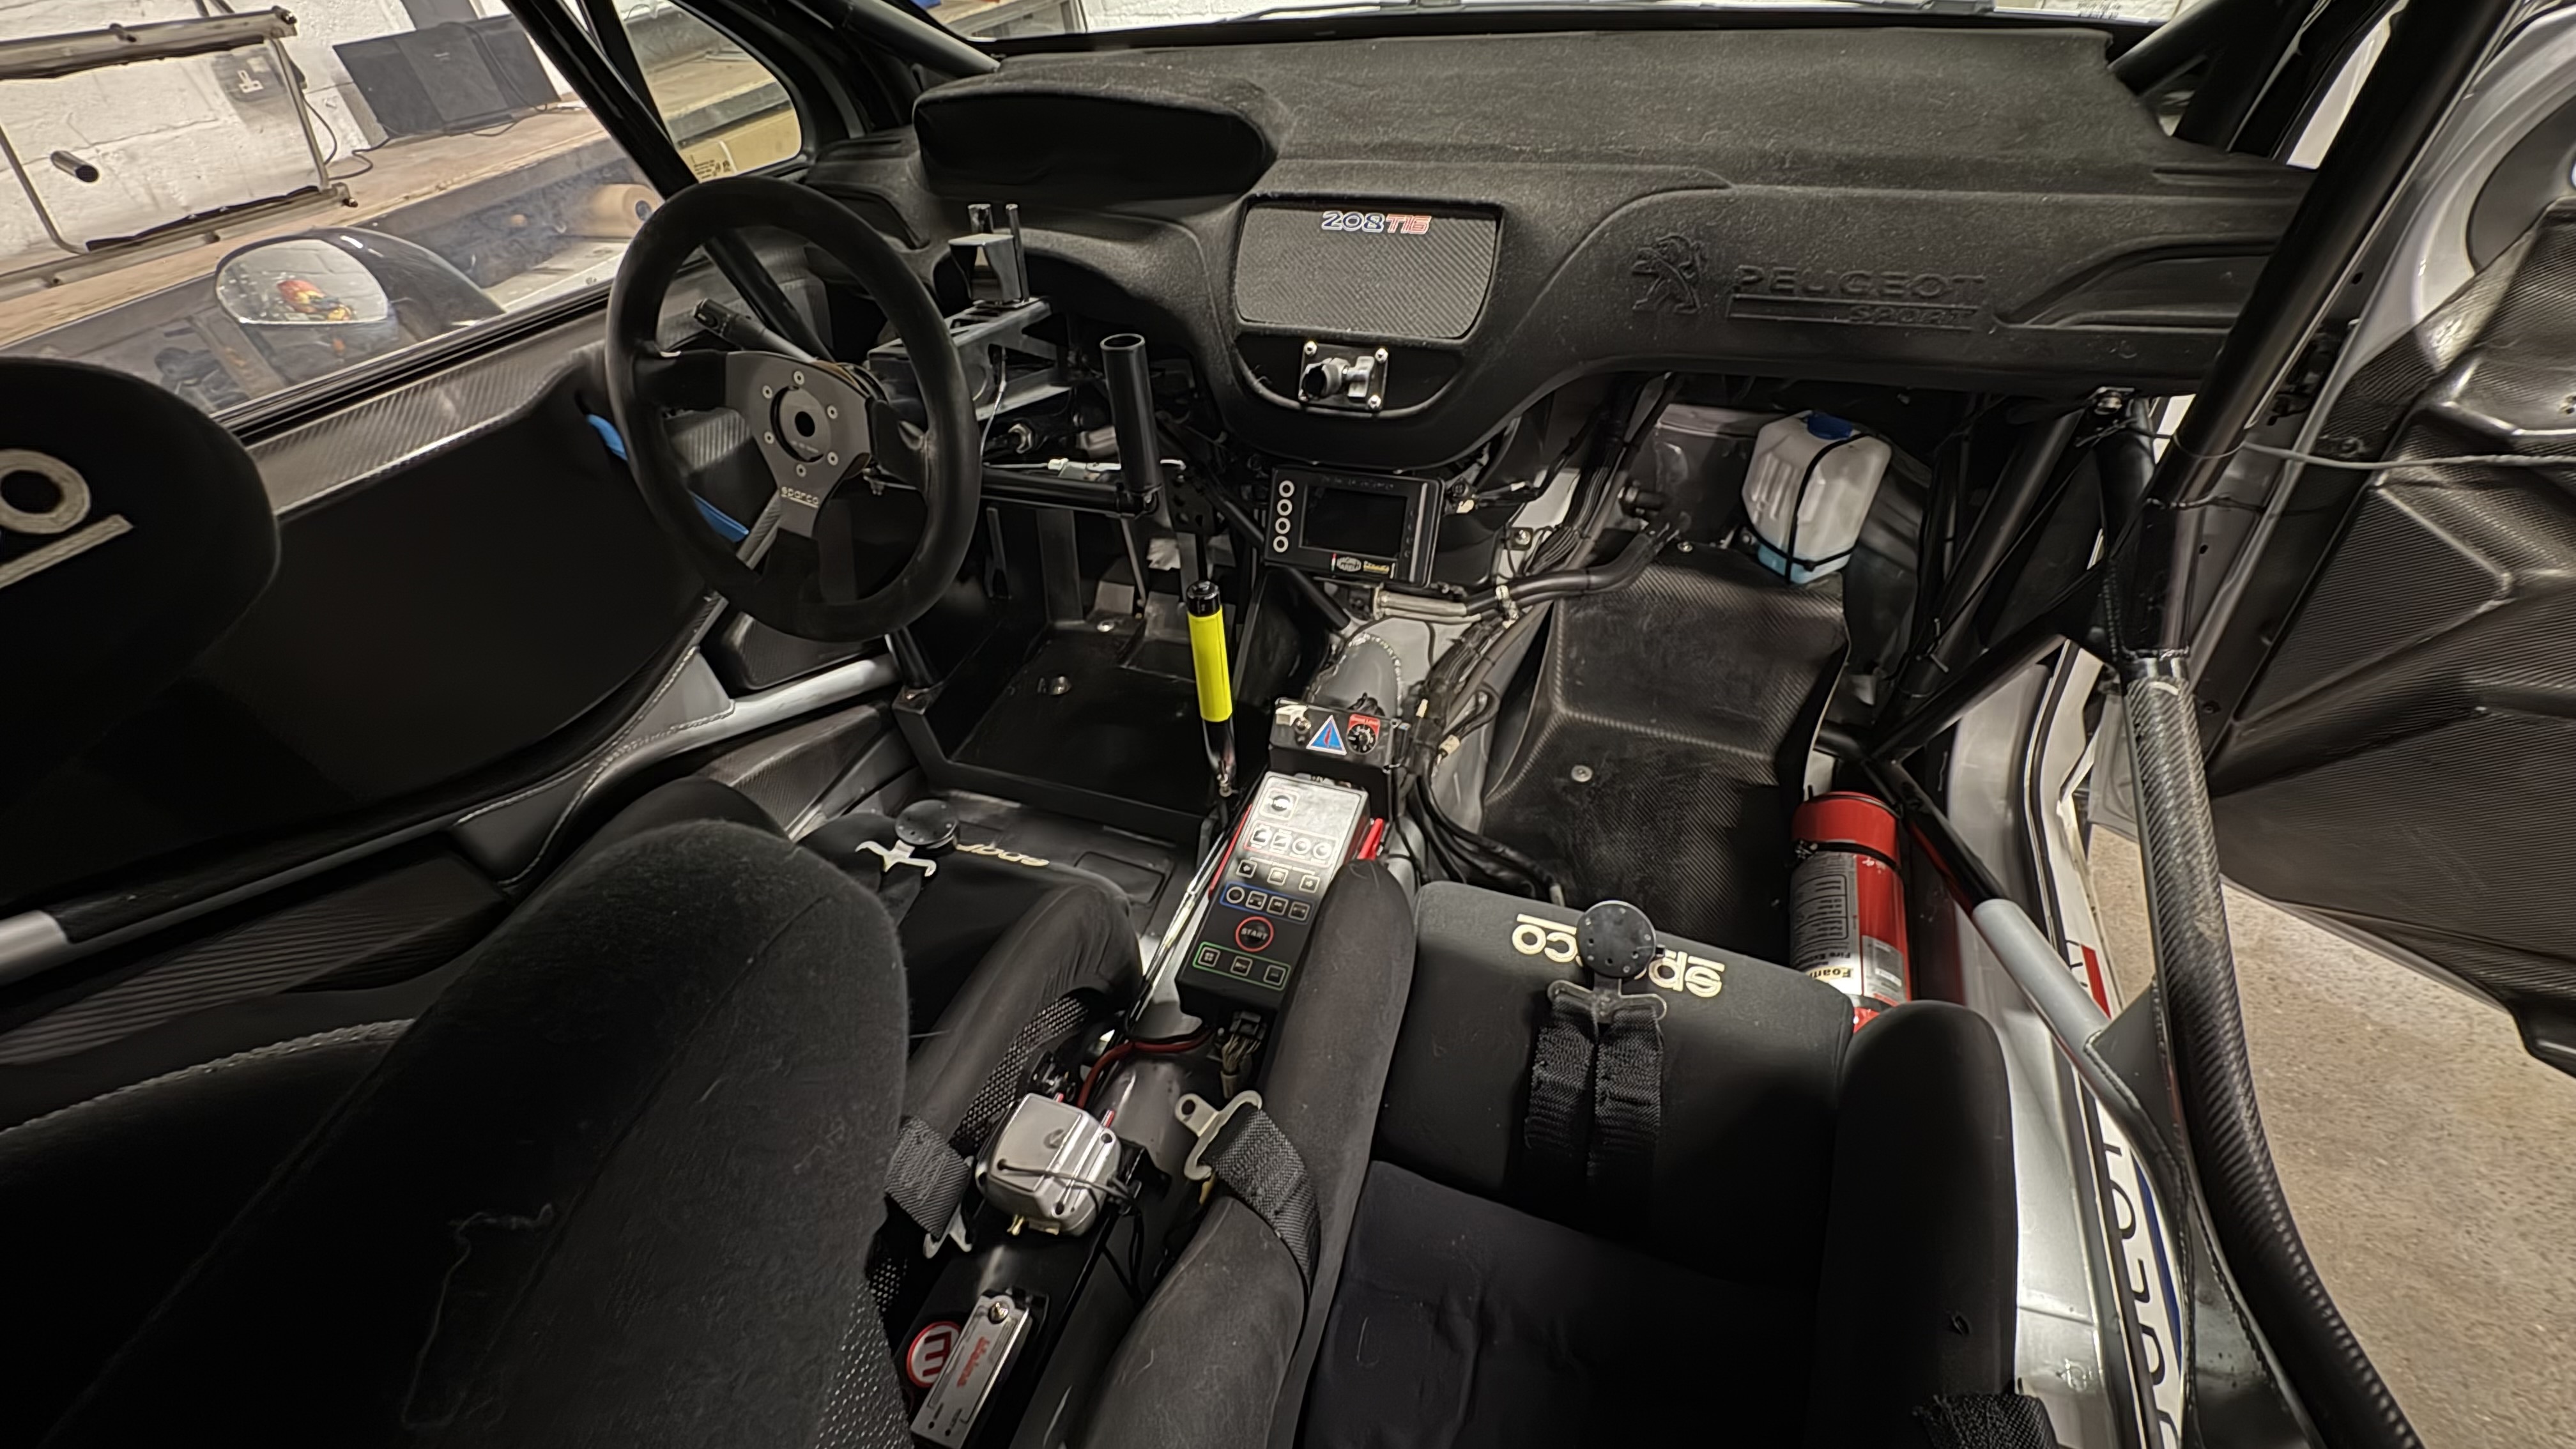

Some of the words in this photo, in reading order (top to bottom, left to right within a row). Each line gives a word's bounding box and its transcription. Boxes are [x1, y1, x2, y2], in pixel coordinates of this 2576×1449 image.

[1735, 265, 1986, 298] PEUGEOT
[1851, 306, 1978, 325] SPORT
[781, 486, 818, 507] sparco
[1241, 928, 1268, 940] START
[1512, 923, 1723, 998] spco
